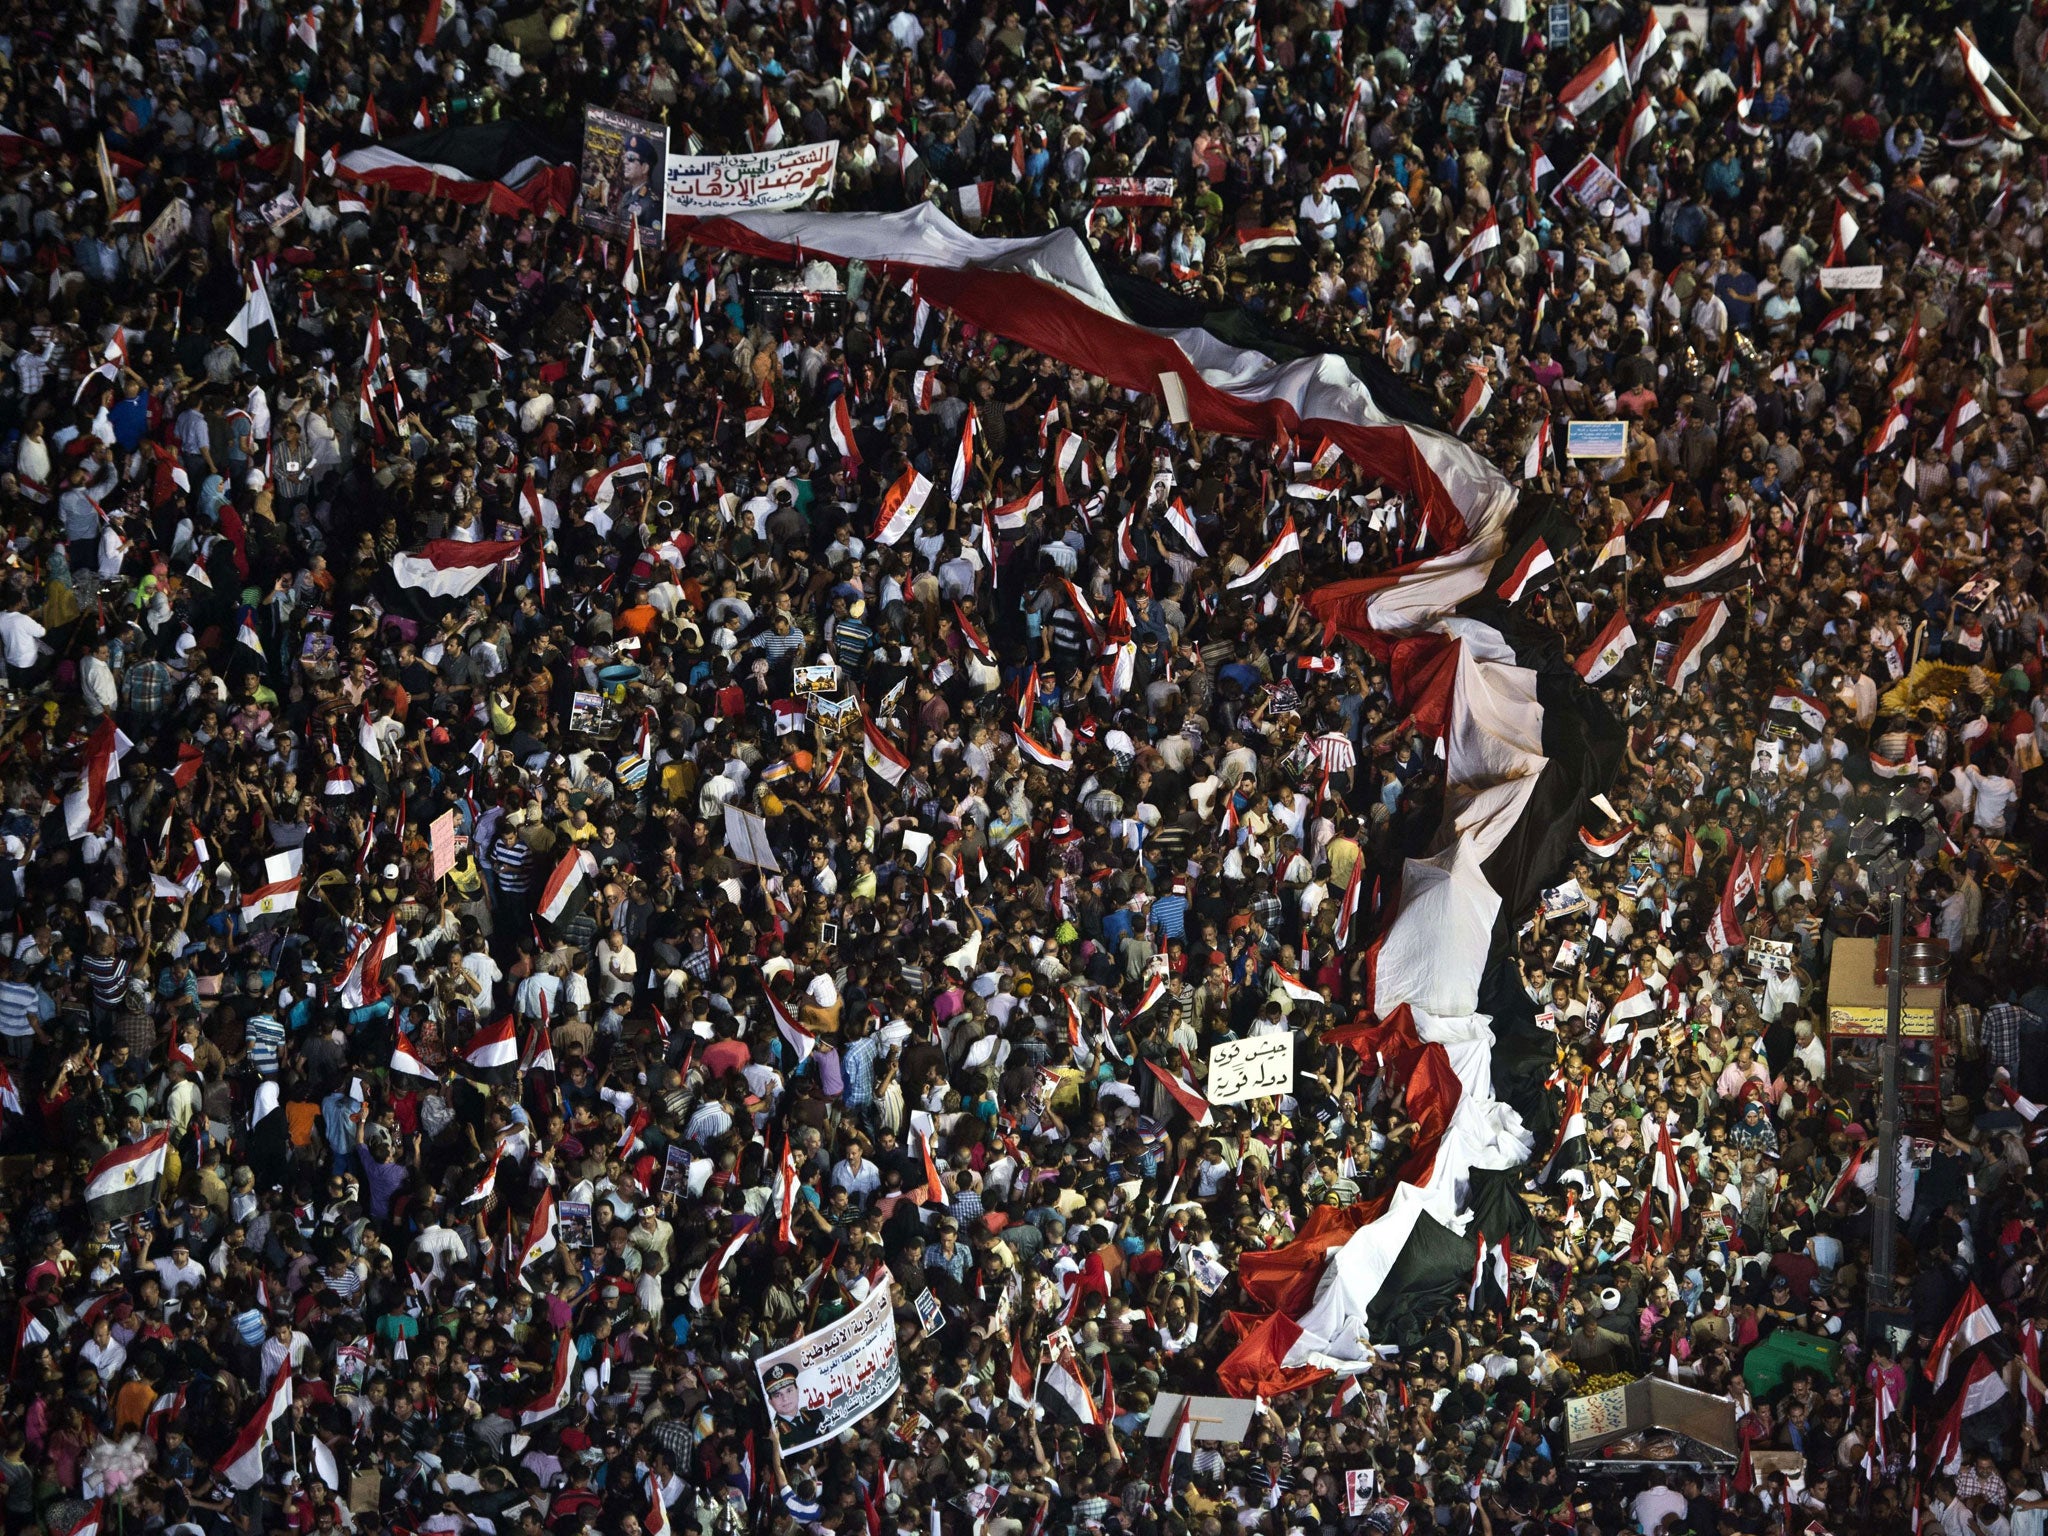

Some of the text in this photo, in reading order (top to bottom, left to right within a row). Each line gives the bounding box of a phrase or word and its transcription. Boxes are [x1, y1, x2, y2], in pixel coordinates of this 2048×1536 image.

[774, 150, 801, 162] مصر
[777, 145, 830, 172] الشعب
[757, 170, 804, 190] ضد
[1245, 1041, 1287, 1062] جيش
[1213, 1071, 1248, 1098] قوية
[853, 1310, 874, 1336] قرية
[819, 1358, 841, 1376] الغربية
[840, 1346, 862, 1364] محافظة
[854, 1351, 879, 1392] الجيش
[804, 1373, 852, 1410] والشرطة
[818, 1405, 844, 1432] الفوضى
